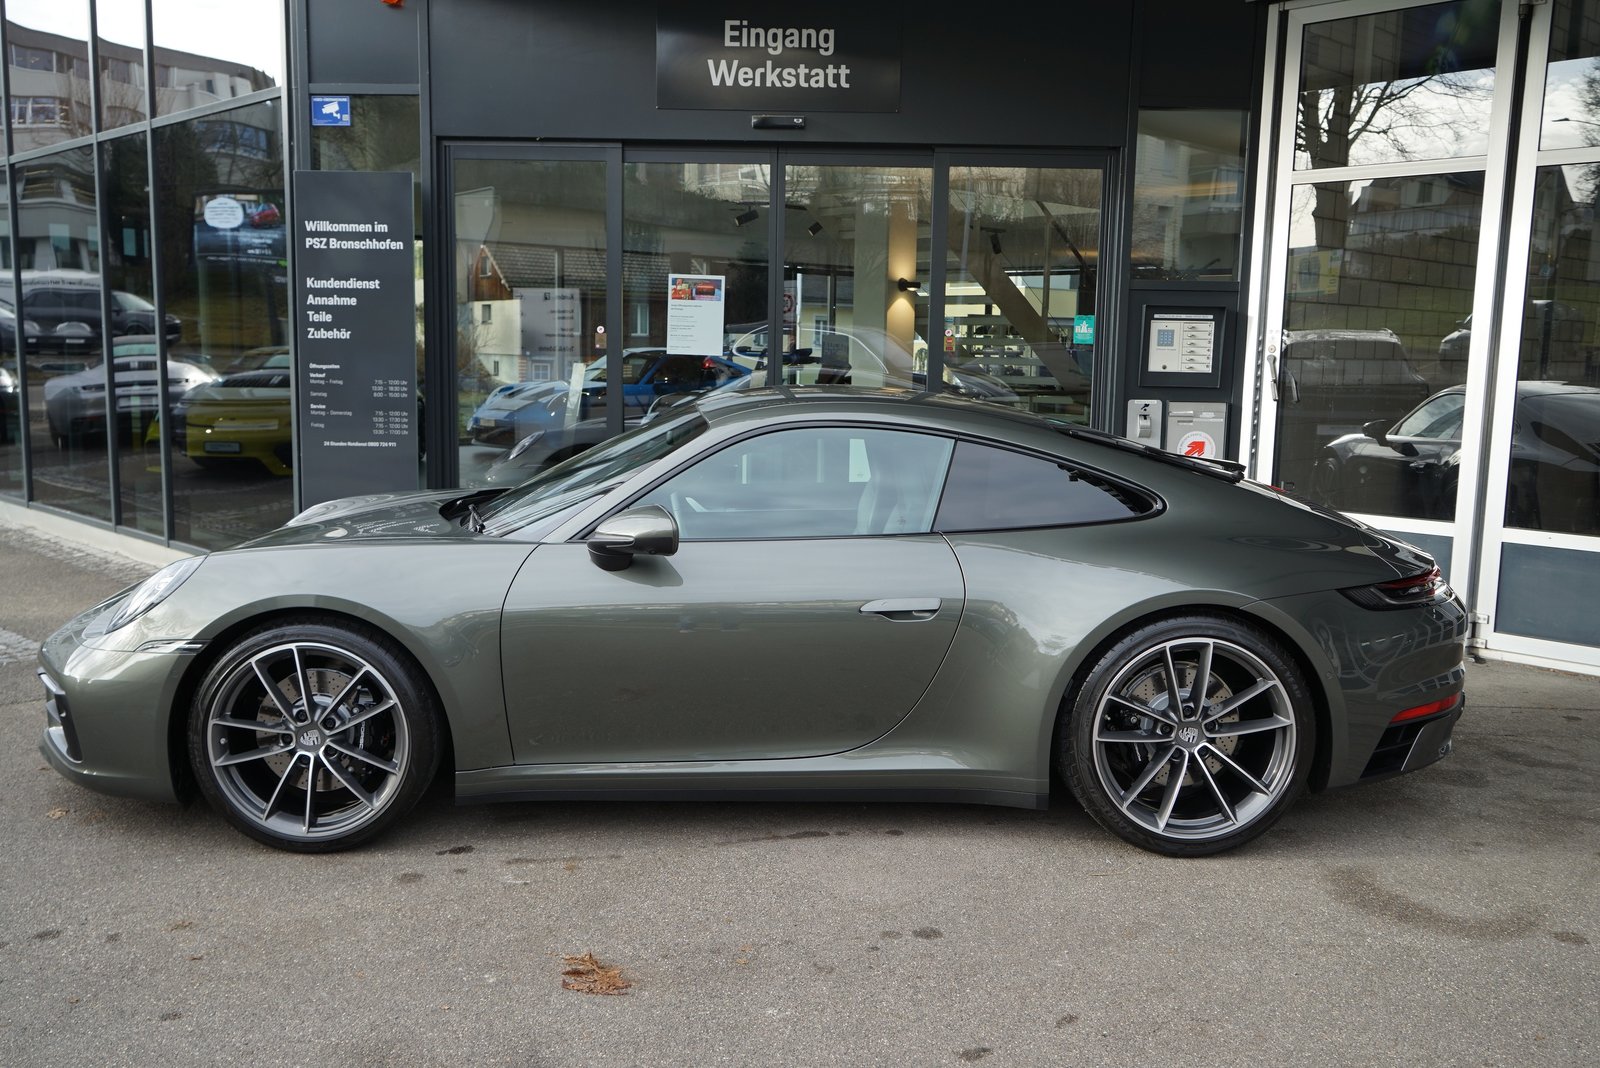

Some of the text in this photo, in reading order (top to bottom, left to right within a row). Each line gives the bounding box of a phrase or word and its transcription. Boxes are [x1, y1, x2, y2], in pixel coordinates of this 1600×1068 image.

[724, 19, 835, 56] Eingang
[707, 59, 850, 88] Werkstatt
[304, 220, 388, 232] Willkommen im
[305, 238, 404, 250] PSZ Bronschhofen
[306, 277, 380, 289] Kundendienst
[306, 294, 357, 305] Annahme
[307, 311, 333, 322] Teile
[307, 328, 351, 339] Zubehör
